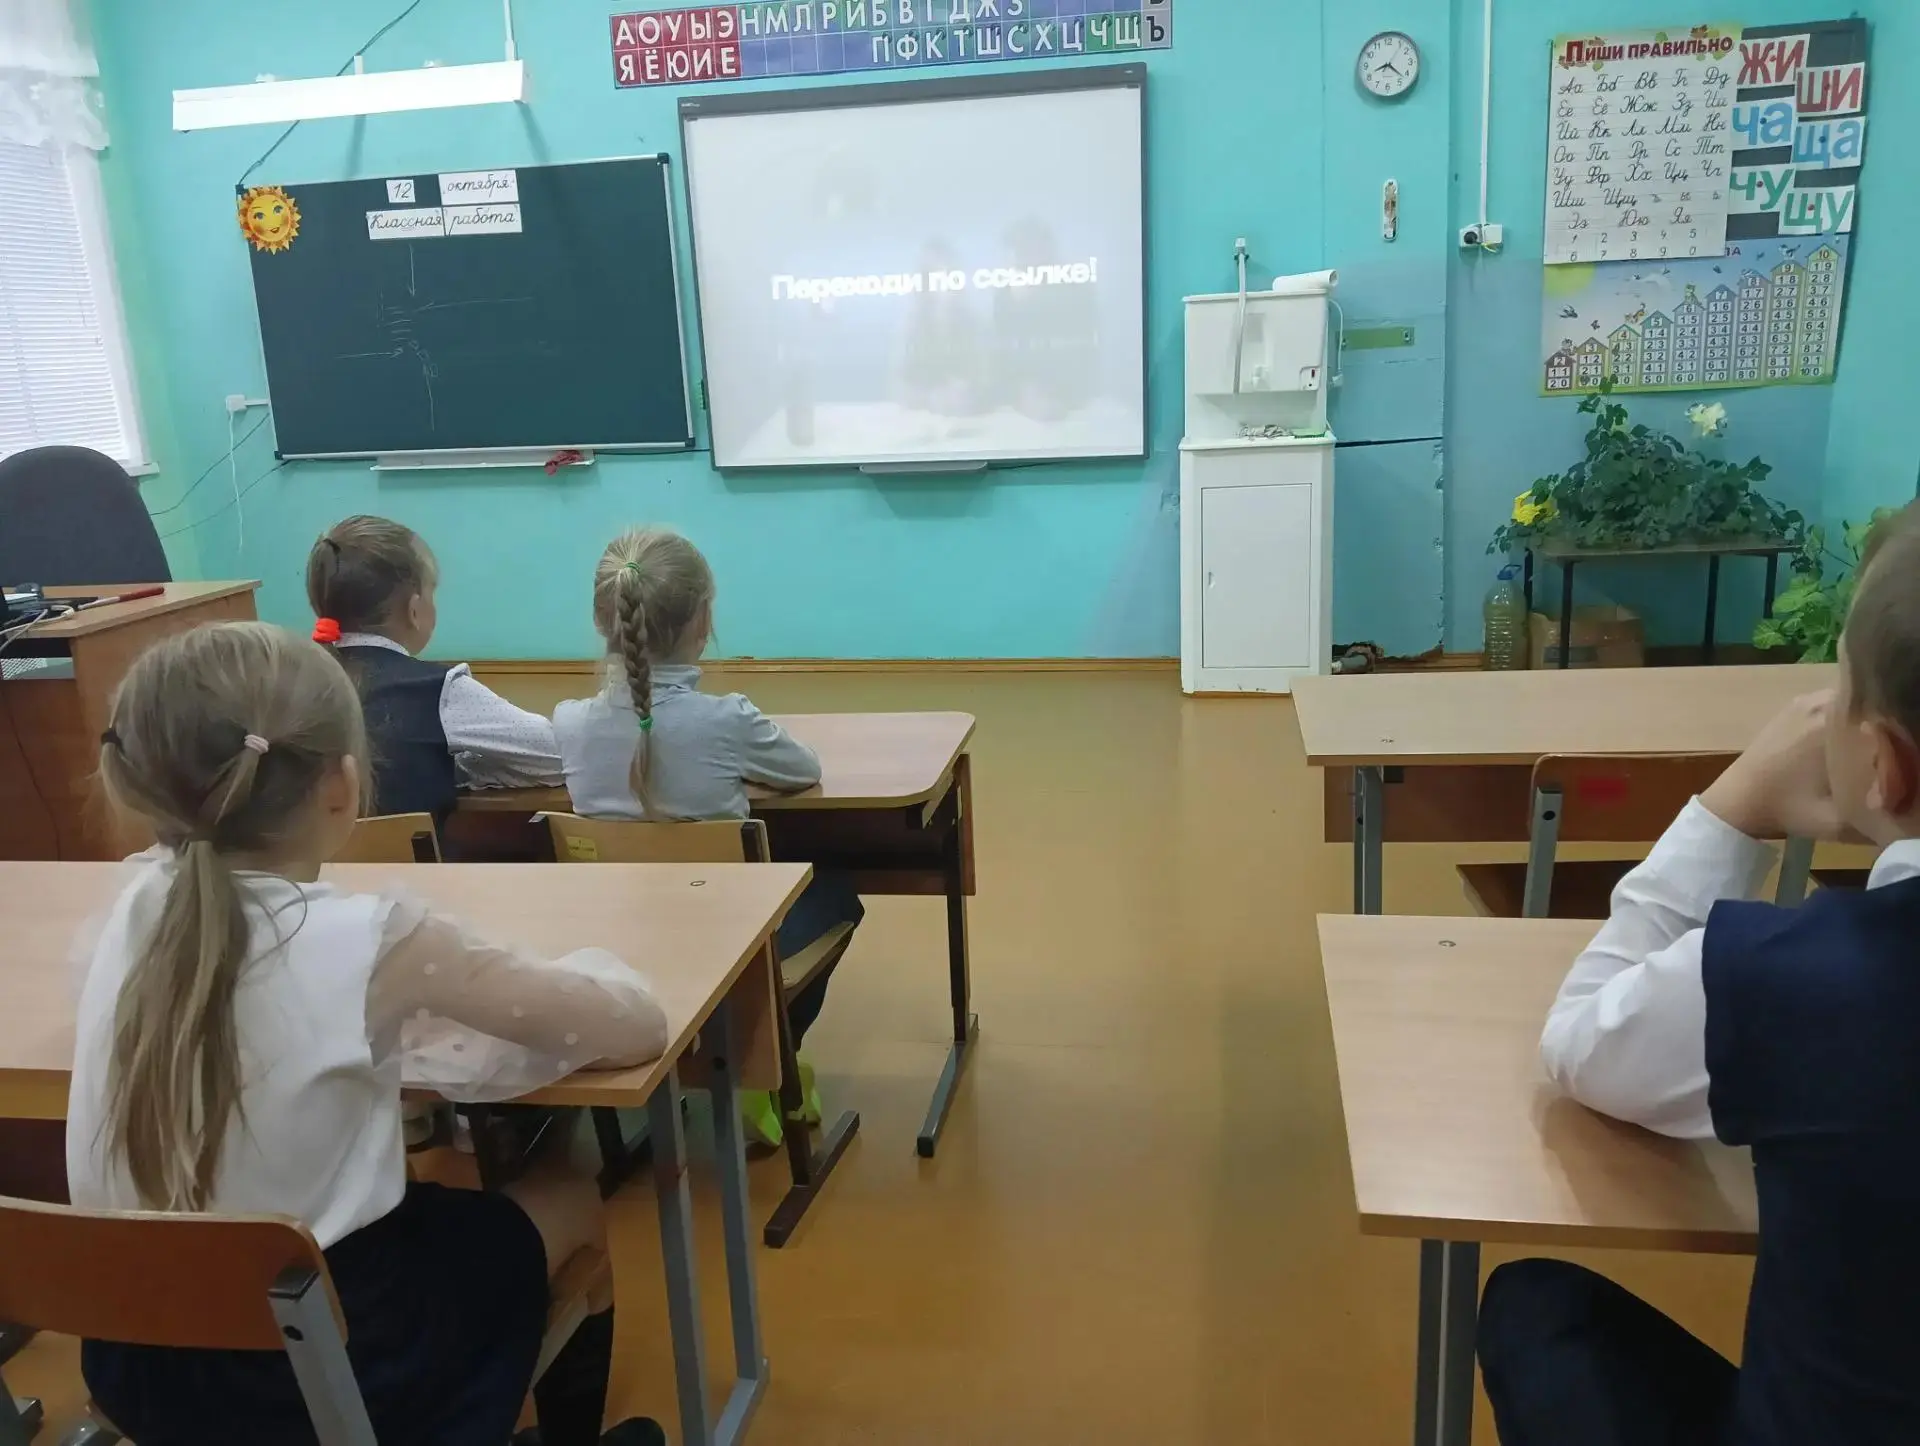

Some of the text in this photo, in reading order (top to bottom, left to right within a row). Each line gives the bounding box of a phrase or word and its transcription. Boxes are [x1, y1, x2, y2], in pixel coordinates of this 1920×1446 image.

[393, 174, 510, 199] 12 октября
[369, 207, 515, 235] Классная работа
[771, 257, 1097, 303] Переходи по ссылке!
